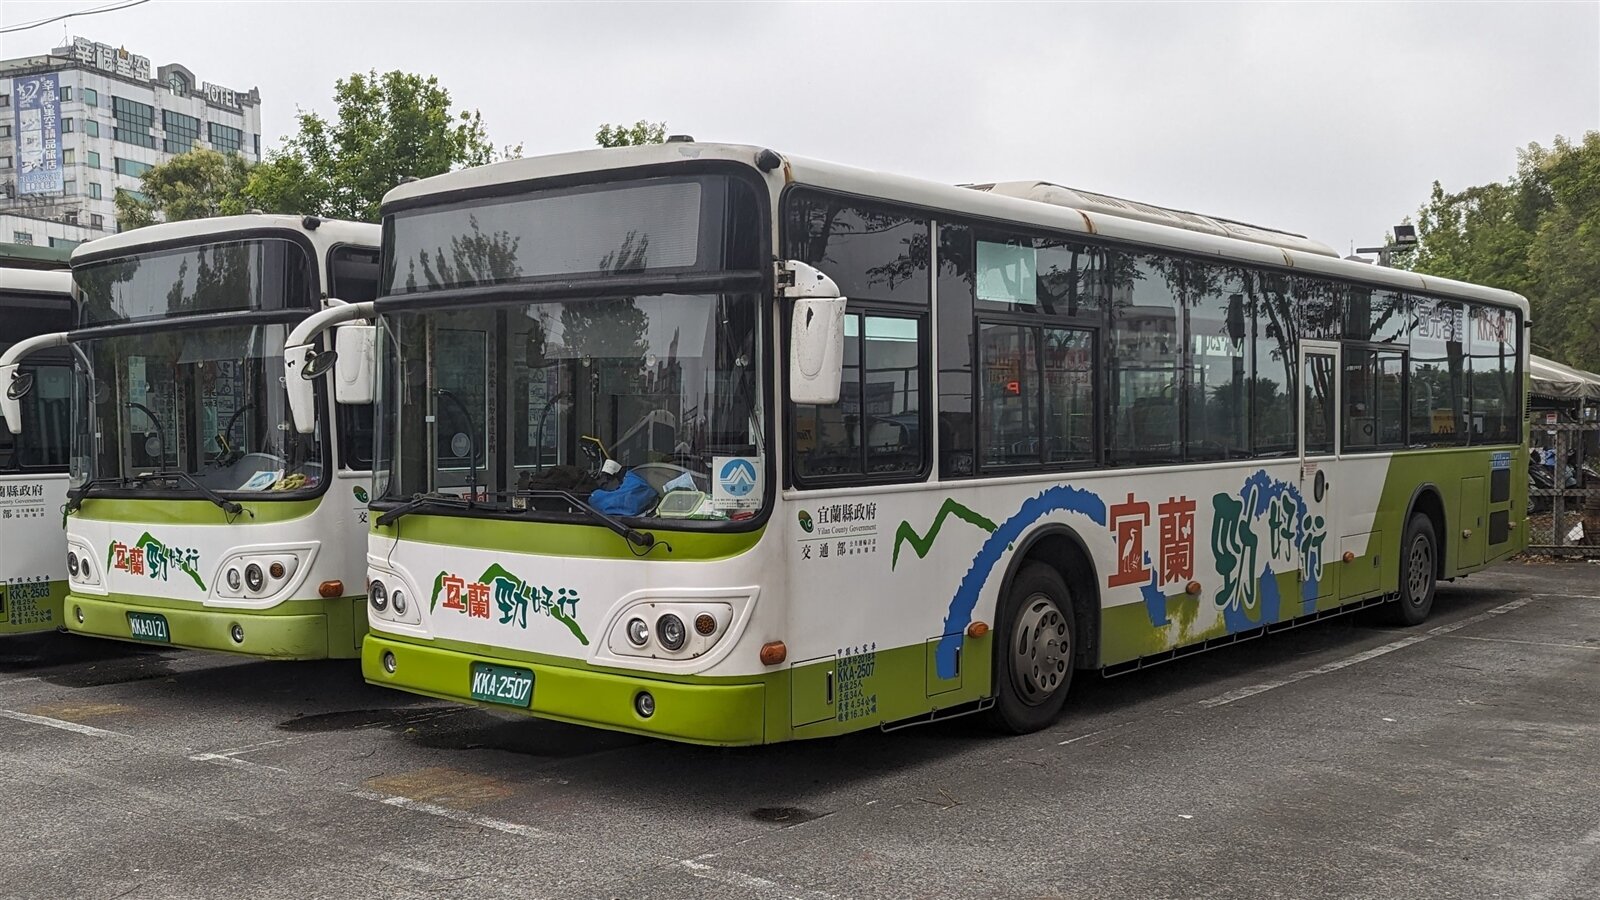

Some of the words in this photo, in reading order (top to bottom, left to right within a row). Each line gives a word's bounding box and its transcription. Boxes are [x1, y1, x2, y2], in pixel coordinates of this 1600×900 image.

[73, 35, 150, 83] 幸福星空
[1418, 303, 1463, 343] 國光客運
[816, 502, 877, 524] 宜蘭縣政府
[817, 527, 831, 535] Yilan
[831, 525, 848, 534] County
[849, 524, 877, 533] Government
[802, 541, 846, 560] 交通部
[10, 588, 50, 600] KKA-2503
[130, 616, 167, 638] KKA-0121
[838, 662, 875, 683] KKA-2507
[472, 671, 532, 700] KKA-2507
